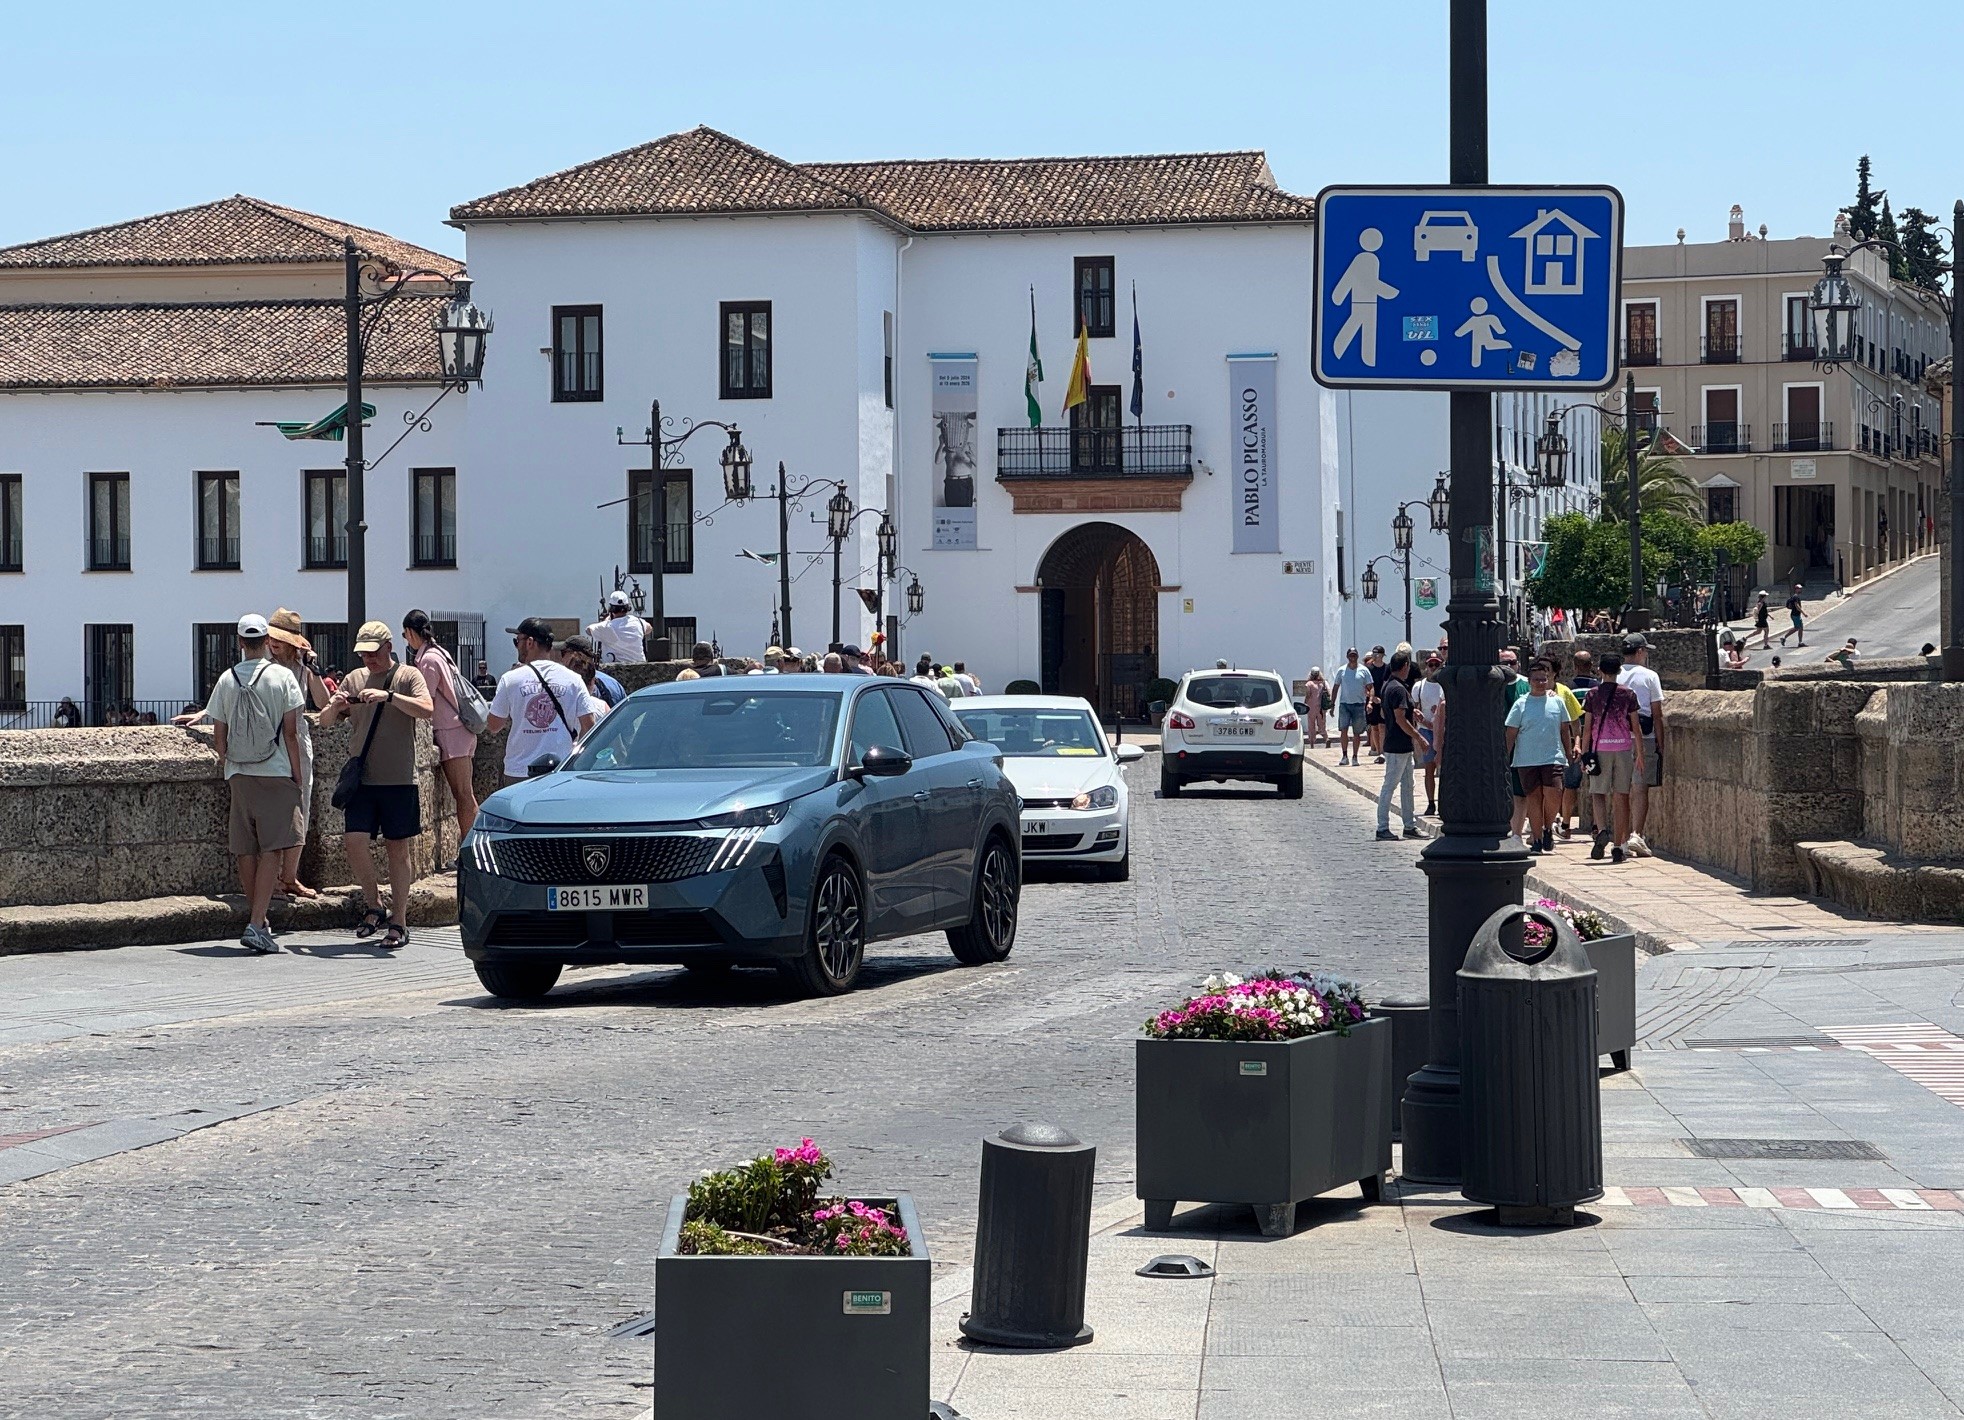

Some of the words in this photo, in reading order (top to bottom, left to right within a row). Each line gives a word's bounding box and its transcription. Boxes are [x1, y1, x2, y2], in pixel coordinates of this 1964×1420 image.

[1242, 388, 1259, 464] PICASSO
[1262, 477, 1267, 487] LA
[1245, 468, 1260, 526] PABLO
[1218, 728, 1238, 736] 3786
[1023, 821, 1046, 834] JKW
[560, 889, 602, 907] 8615
[609, 888, 644, 906] MWR
